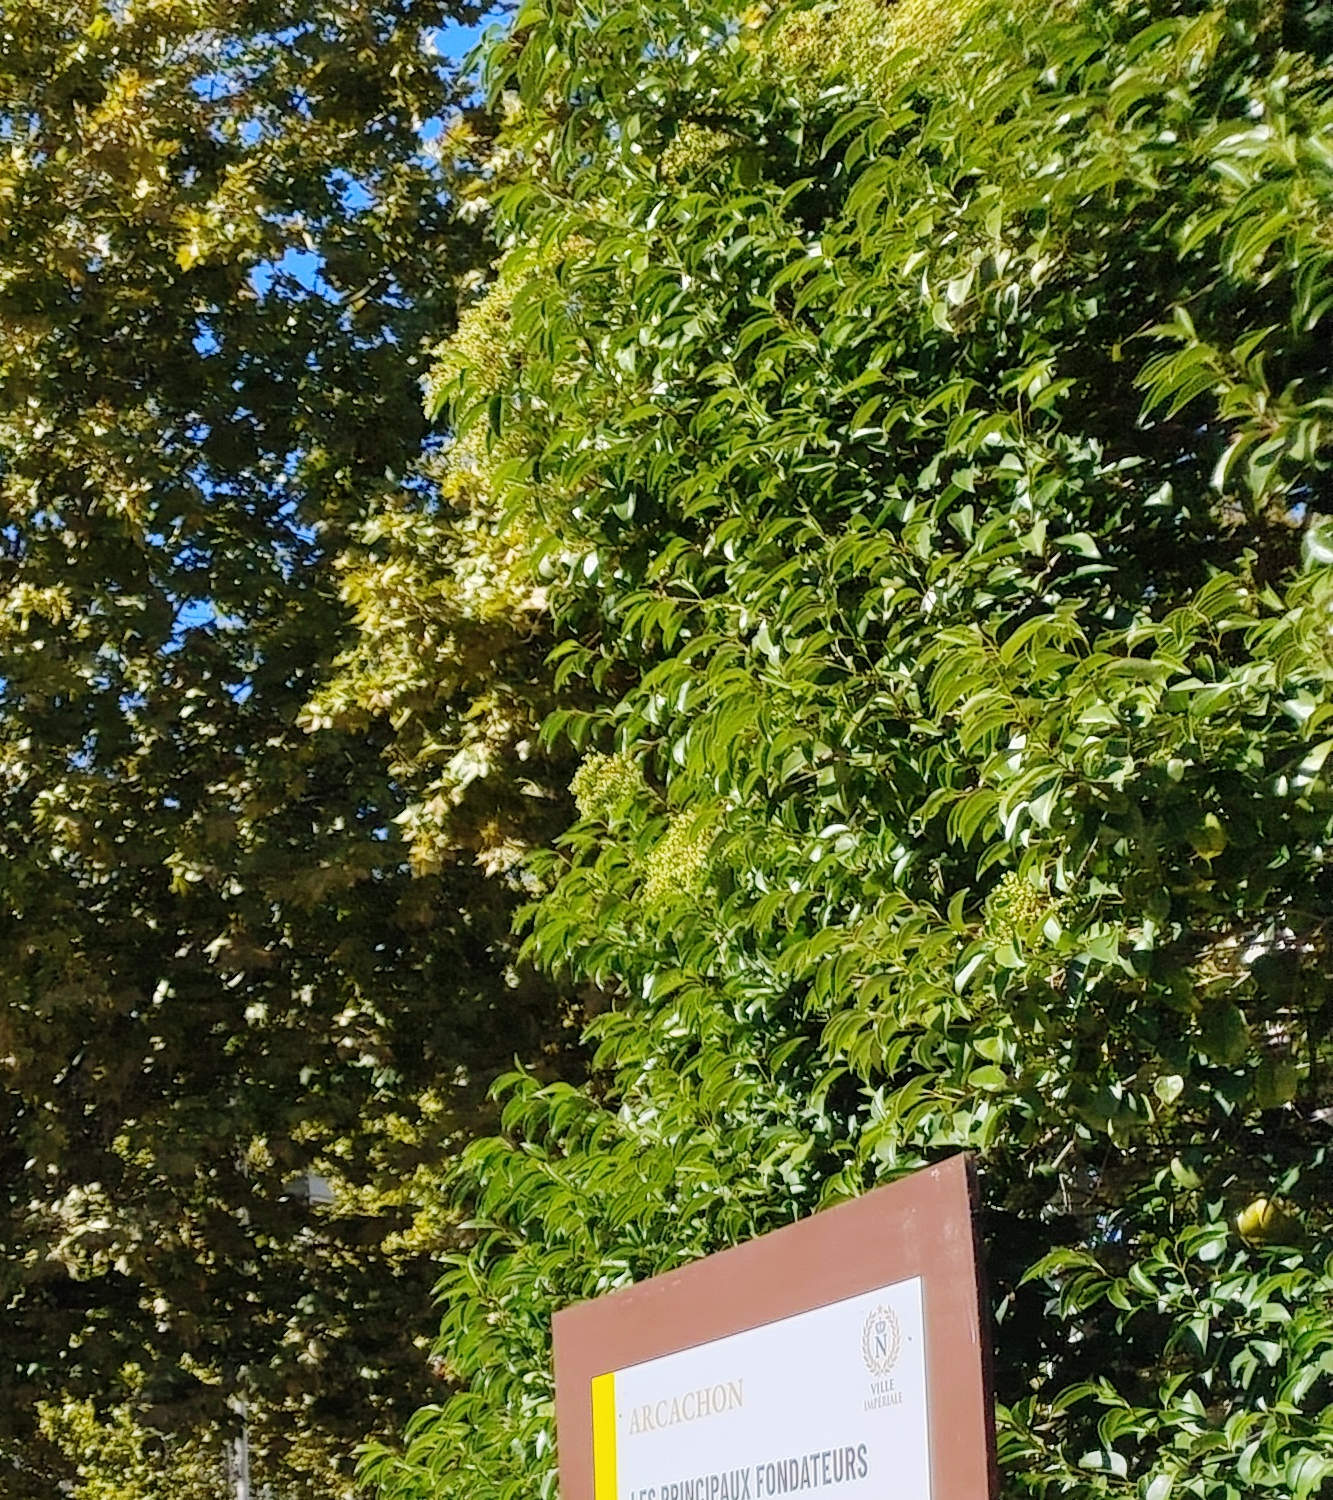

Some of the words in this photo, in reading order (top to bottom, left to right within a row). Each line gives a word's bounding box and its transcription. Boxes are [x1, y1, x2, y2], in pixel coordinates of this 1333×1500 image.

[628, 1378, 744, 1436] ARCACHON
[864, 1389, 903, 1411] IMPÉRIALE
[871, 1380, 895, 1395] VILLE
[756, 1442, 869, 1500] FONDATEURS
